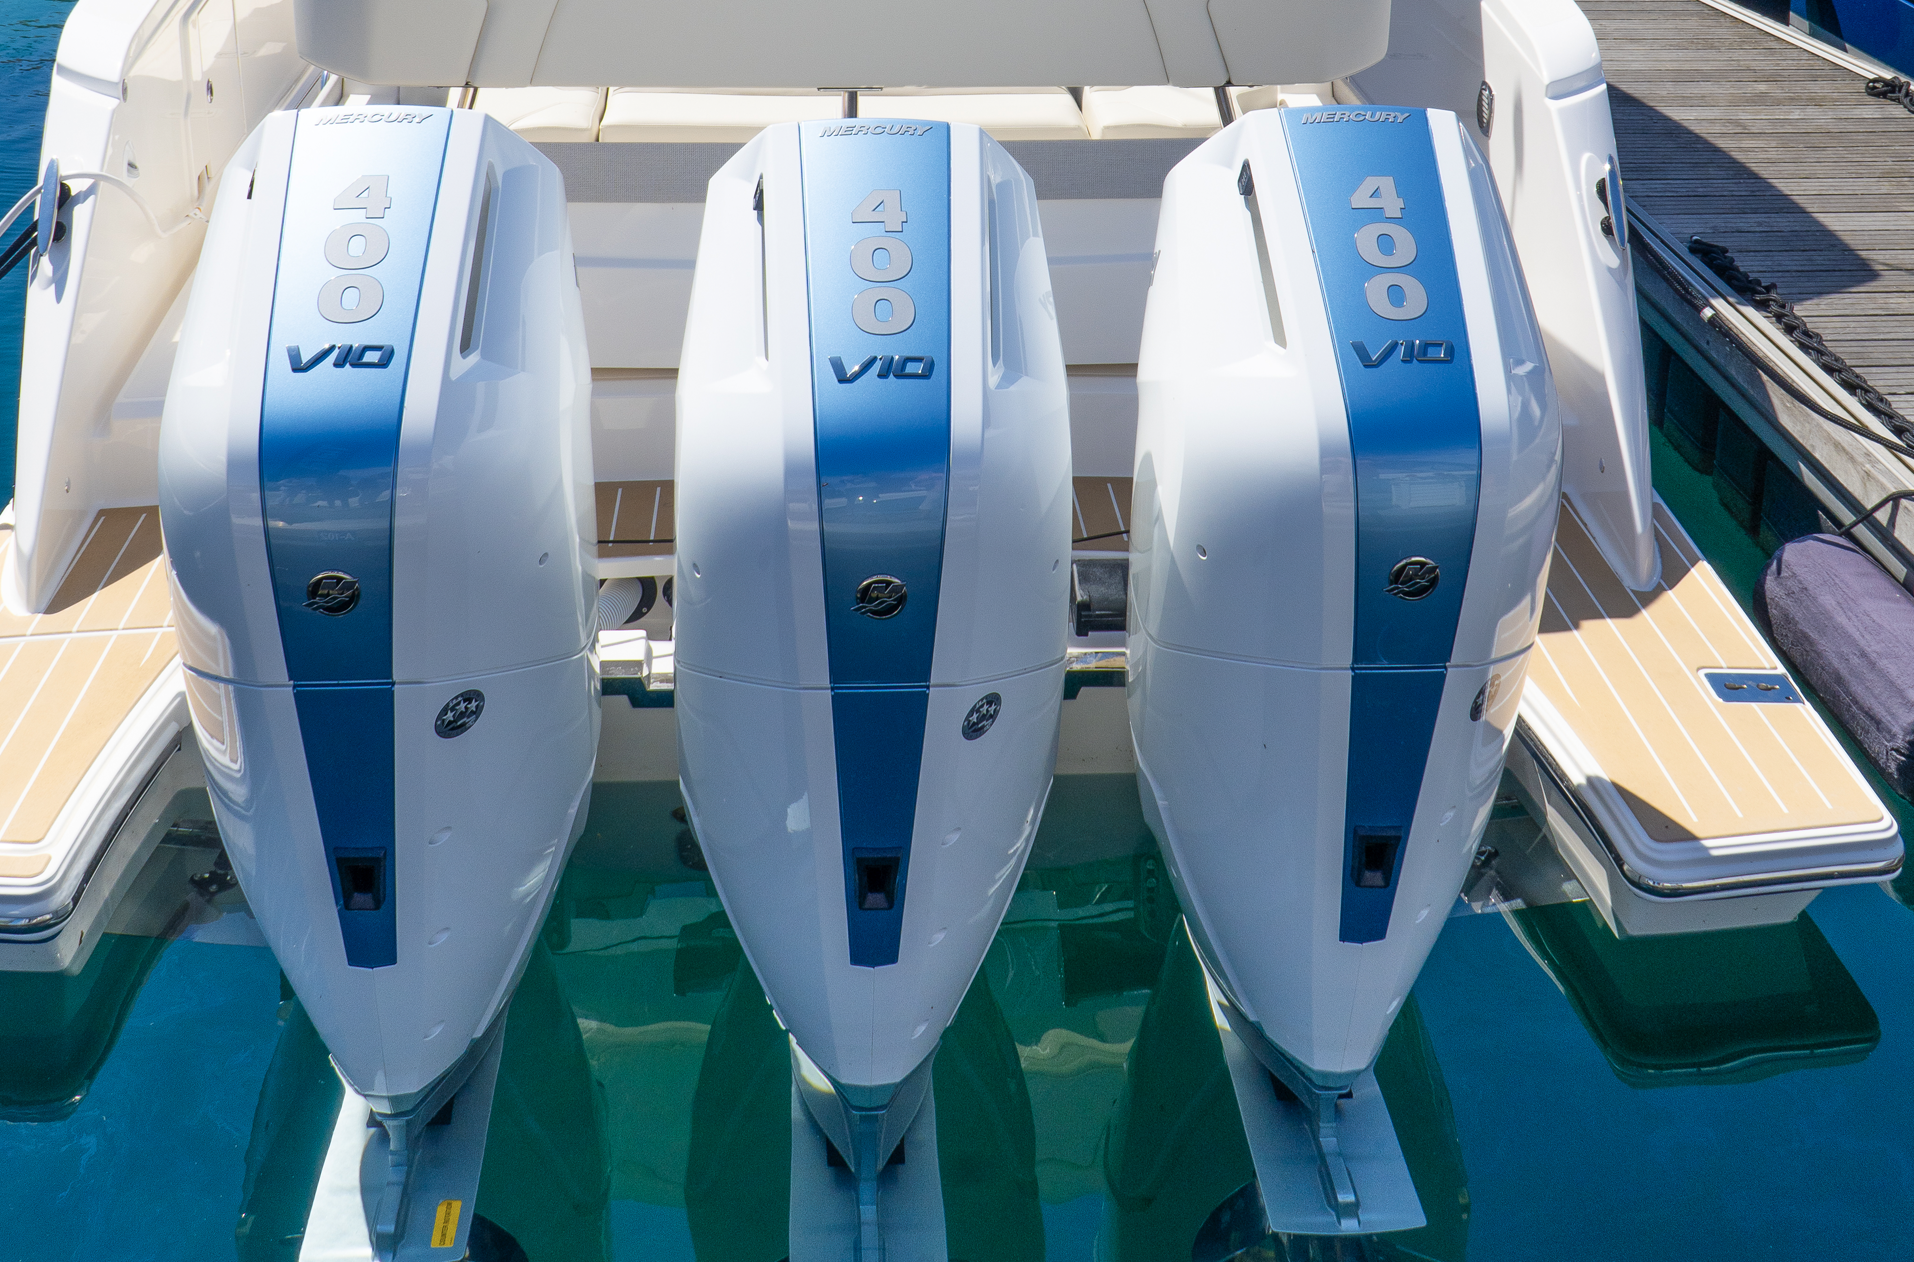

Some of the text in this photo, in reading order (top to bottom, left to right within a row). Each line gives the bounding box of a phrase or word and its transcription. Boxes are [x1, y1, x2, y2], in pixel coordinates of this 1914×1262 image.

[314, 111, 433, 126] MERCURY
[819, 124, 933, 138] MERCURY
[1302, 111, 1411, 124] MERCURY
[317, 175, 392, 324] 400
[850, 189, 916, 335] 400
[1350, 176, 1429, 321] 400
[285, 343, 395, 373] V10
[1350, 339, 1455, 368] V10
[827, 354, 935, 383] V10
